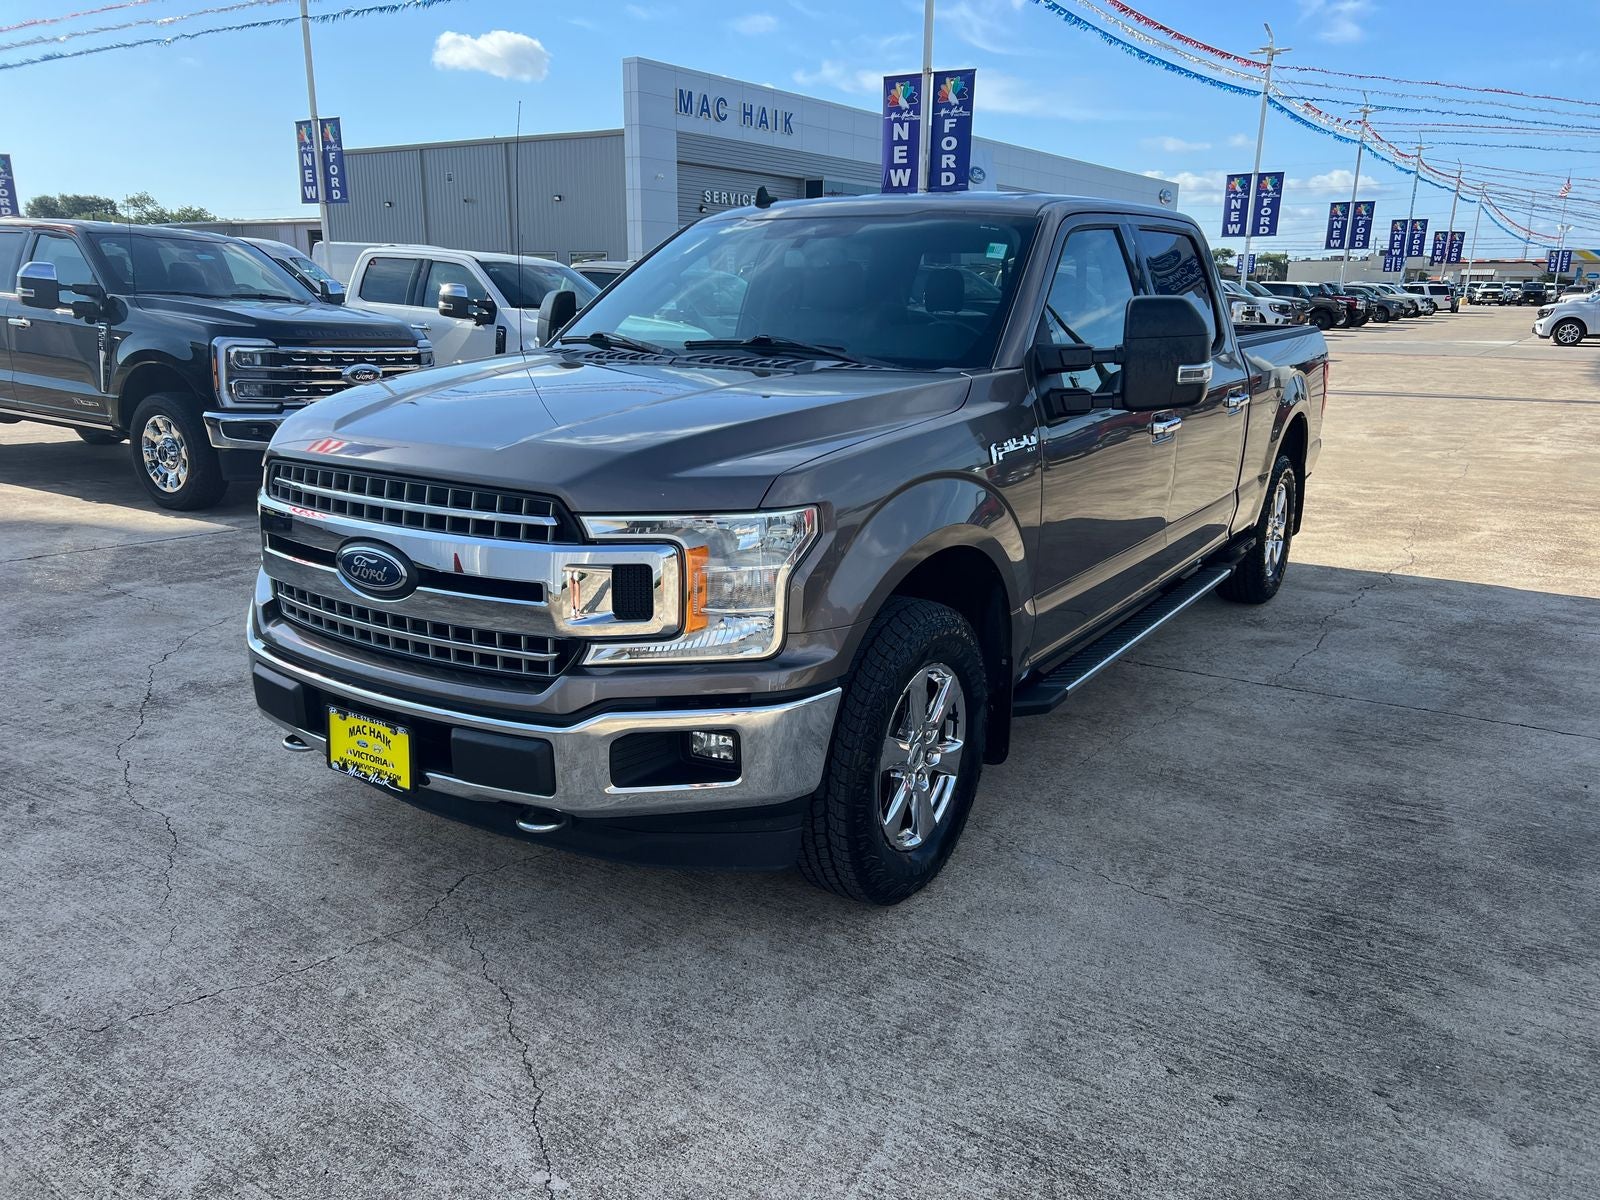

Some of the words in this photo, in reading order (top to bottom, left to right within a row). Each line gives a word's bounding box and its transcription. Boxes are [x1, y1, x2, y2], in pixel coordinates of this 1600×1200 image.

[677, 88, 728, 122] MAC
[741, 102, 793, 134] HAIK
[890, 122, 911, 187] NEW
[940, 119, 958, 186] FORD
[303, 153, 316, 199] NEW
[329, 152, 340, 200] FORD
[704, 190, 756, 206] SERVICE
[1227, 199, 1241, 234] NEW
[1259, 198, 1272, 235] FORD
[1330, 221, 1341, 247] NEW
[1355, 220, 1365, 248] FORD
[1392, 235, 1402, 256] NEW
[1412, 233, 1420, 256] FORD
[1434, 243, 1443, 261] NEW
[1450, 243, 1459, 262] FORD
[356, 369, 374, 380] Ford
[350, 555, 388, 582] Ford
[348, 725, 367, 738] MAC
[369, 725, 391, 750] HAIK
[352, 748, 388, 767] VICTORIA
[347, 765, 365, 777] Mac
[368, 772, 390, 786] Haik
